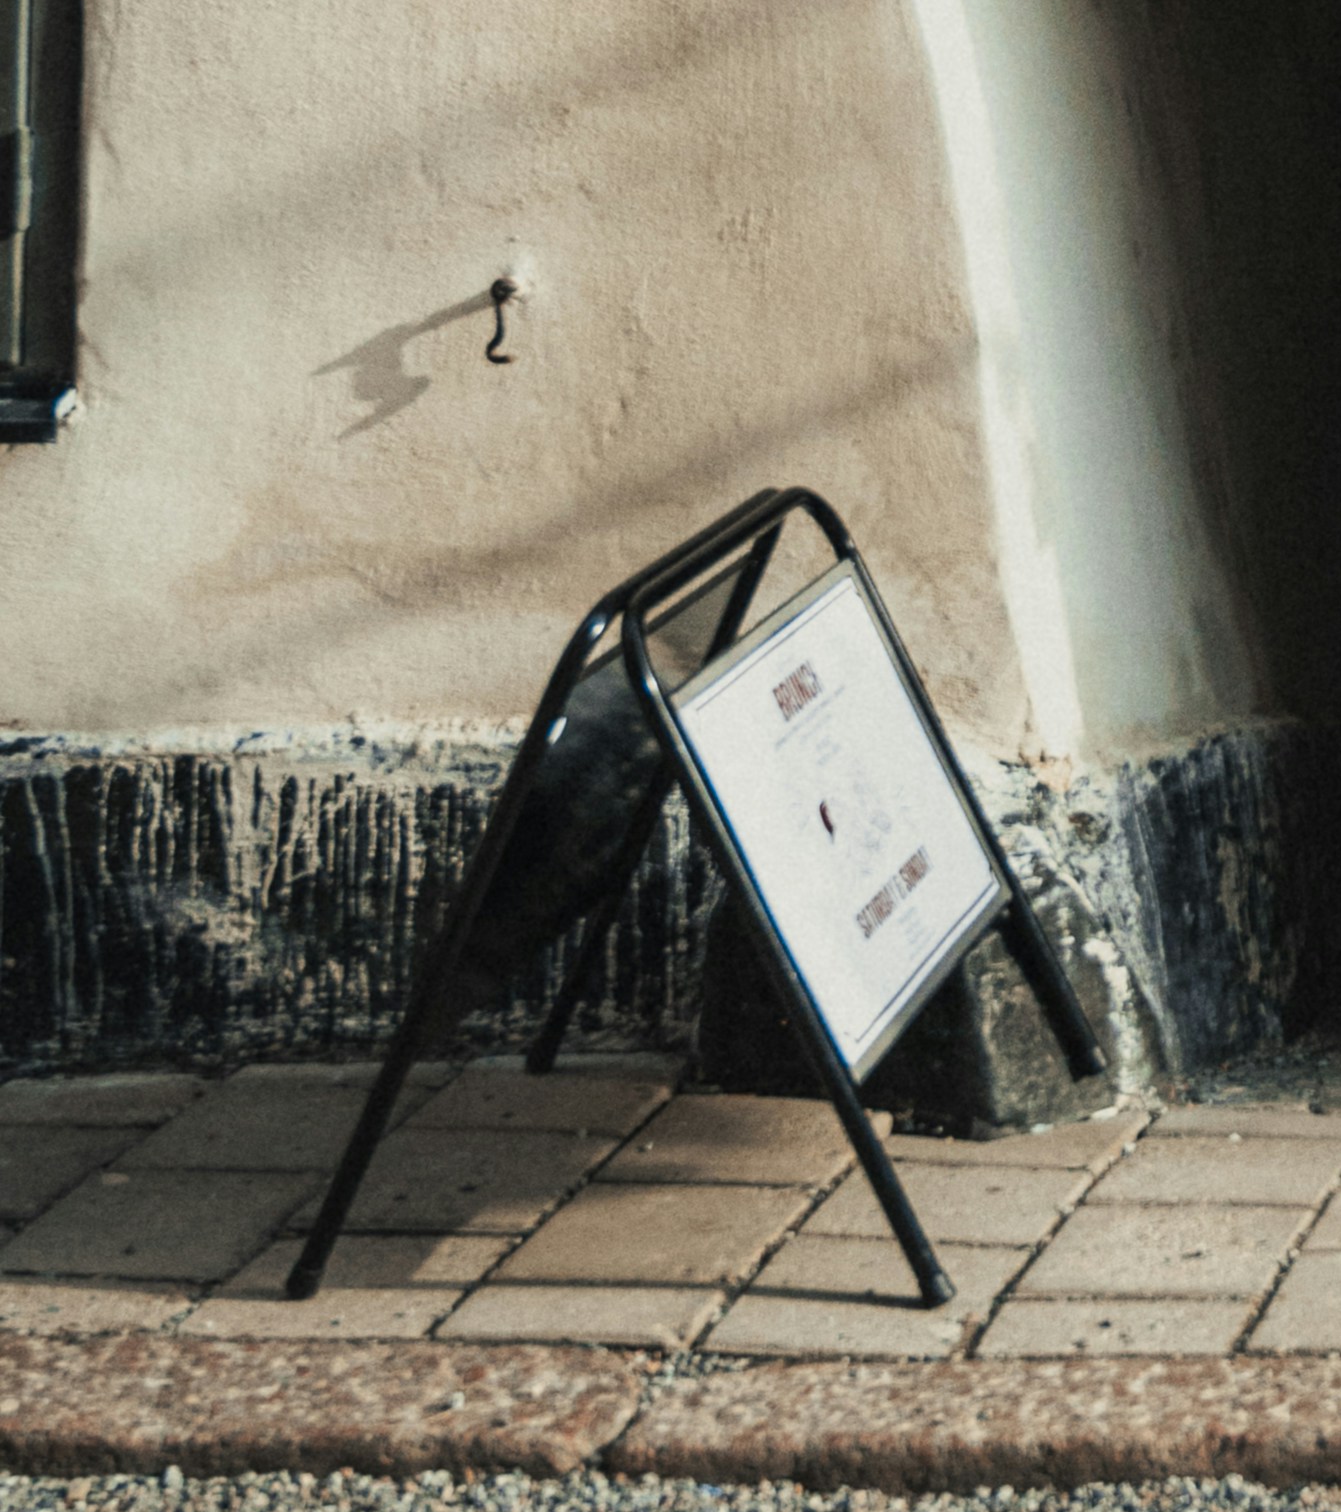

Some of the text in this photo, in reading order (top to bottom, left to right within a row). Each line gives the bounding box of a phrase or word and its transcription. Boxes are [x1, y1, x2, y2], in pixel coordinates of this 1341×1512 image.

[771, 659, 824, 722] BRUNCH
[855, 879, 898, 939] SATURDAY
[898, 845, 933, 892] SUNDAY
